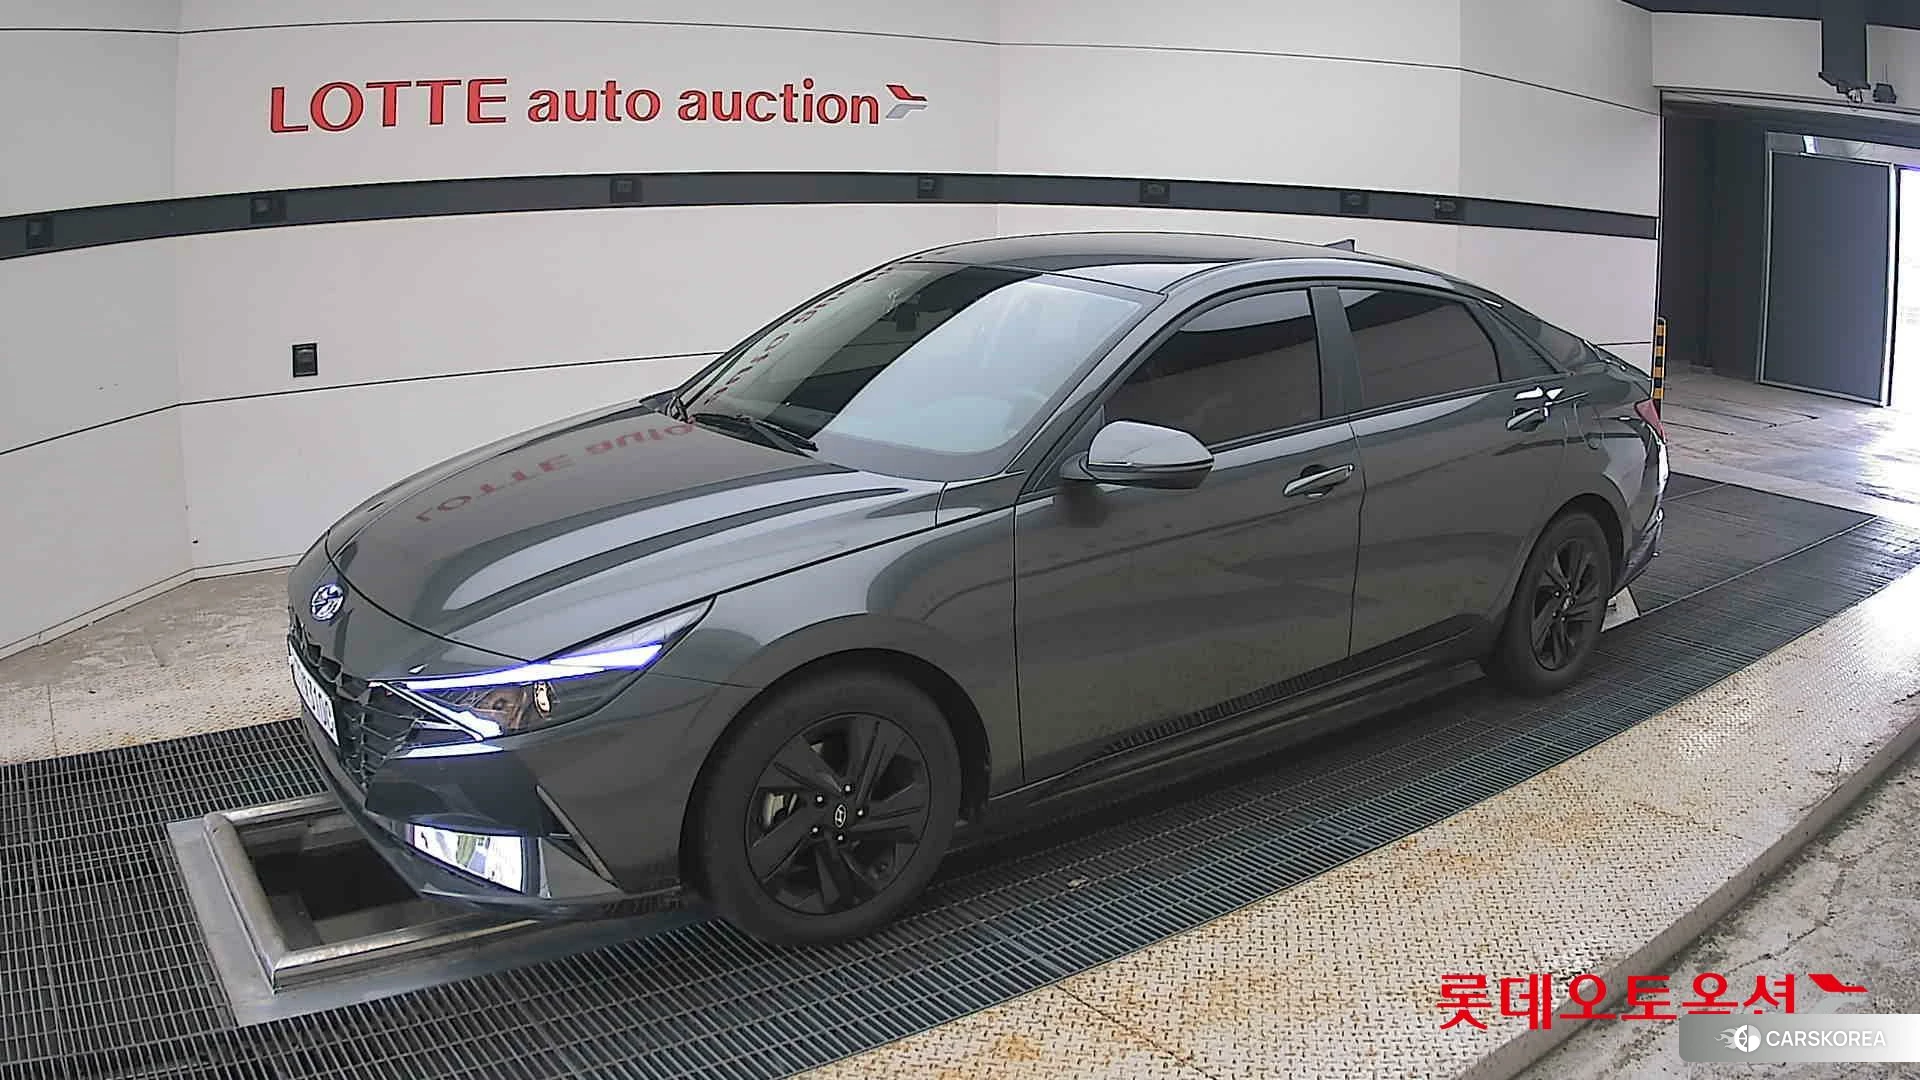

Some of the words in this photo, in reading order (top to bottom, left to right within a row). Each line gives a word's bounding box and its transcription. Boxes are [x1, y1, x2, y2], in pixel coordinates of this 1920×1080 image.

[270, 78, 508, 133] LOTTE
[527, 80, 661, 123] auto
[677, 78, 880, 124] auction
